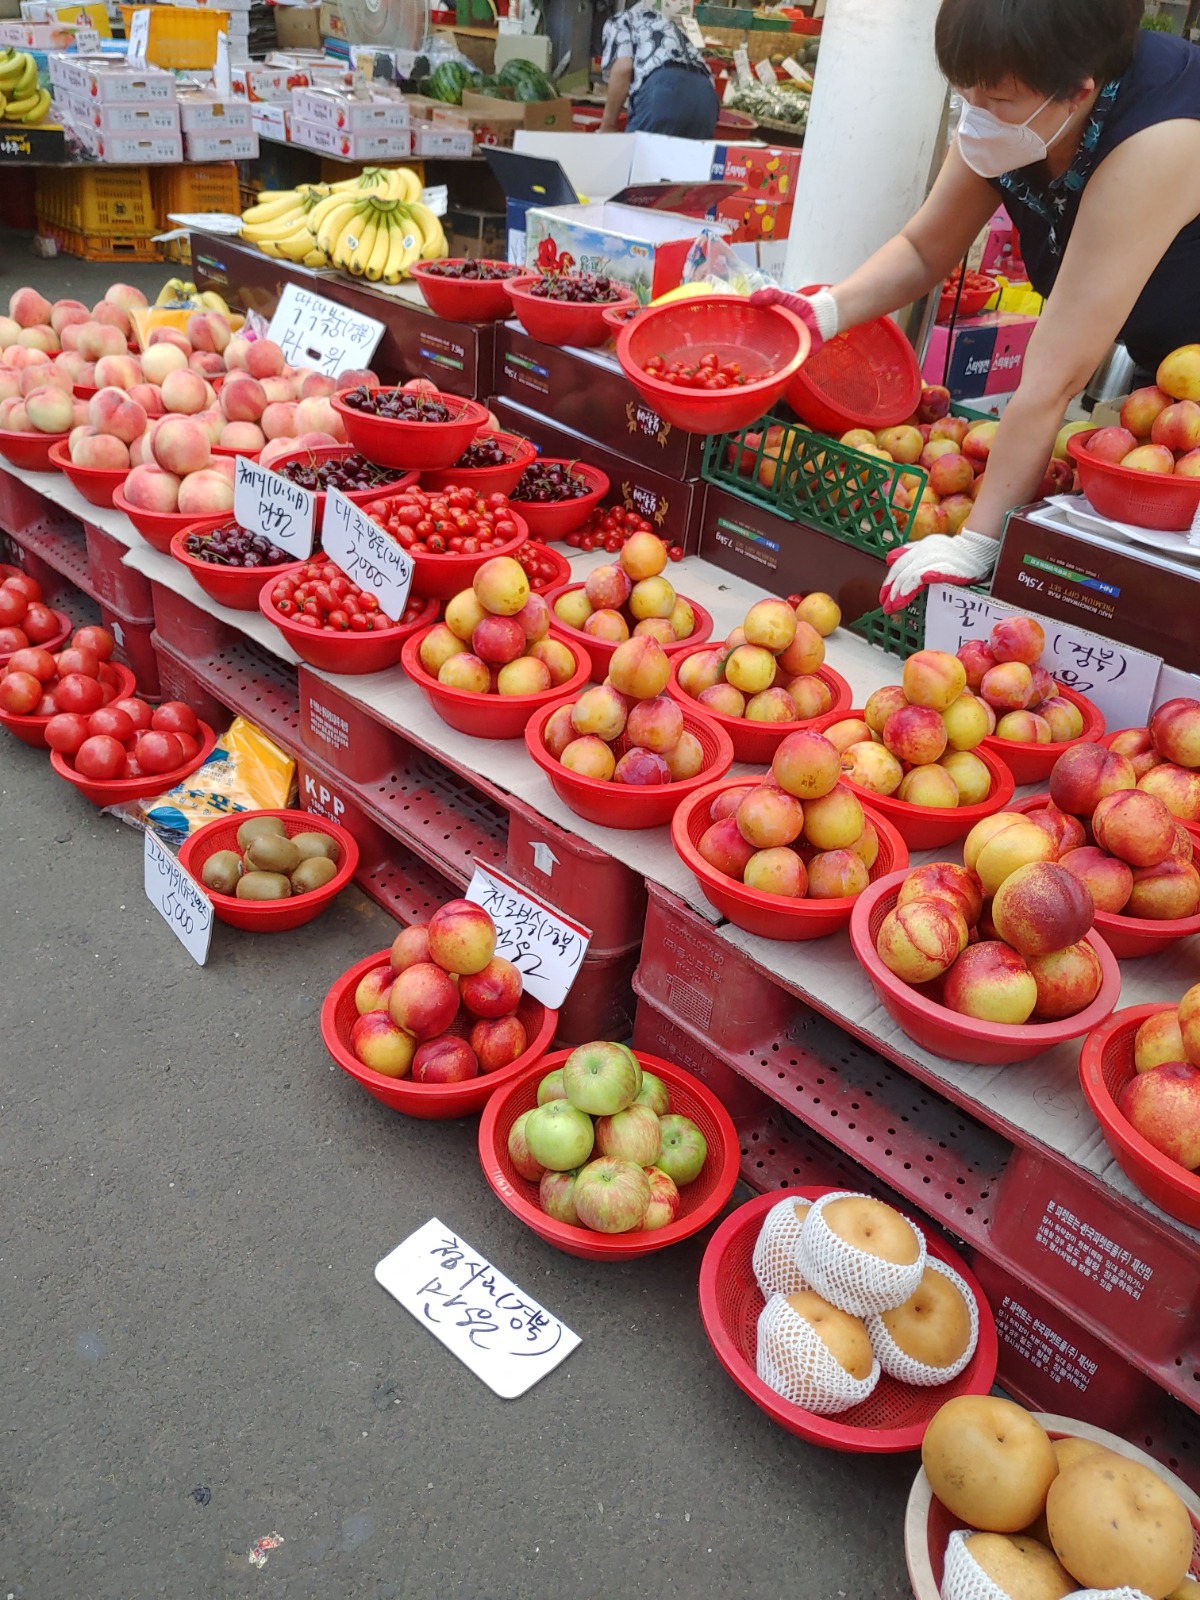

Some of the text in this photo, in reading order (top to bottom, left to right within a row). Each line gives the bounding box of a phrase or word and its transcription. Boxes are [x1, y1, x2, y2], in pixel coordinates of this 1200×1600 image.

[1017, 571, 1045, 592] 7.5kg
[1048, 583, 1115, 613] PREMIUM GIFT SET
[1099, 583, 1114, 594] NH
[304, 773, 345, 817] KPP
[1046, 1200, 1056, 1214] 본
[1054, 1205, 1081, 1232] 파렛트는
[1130, 1258, 1154, 1281] 재산임
[1002, 1295, 1011, 1308] 본
[1077, 1354, 1099, 1376] 재산임
